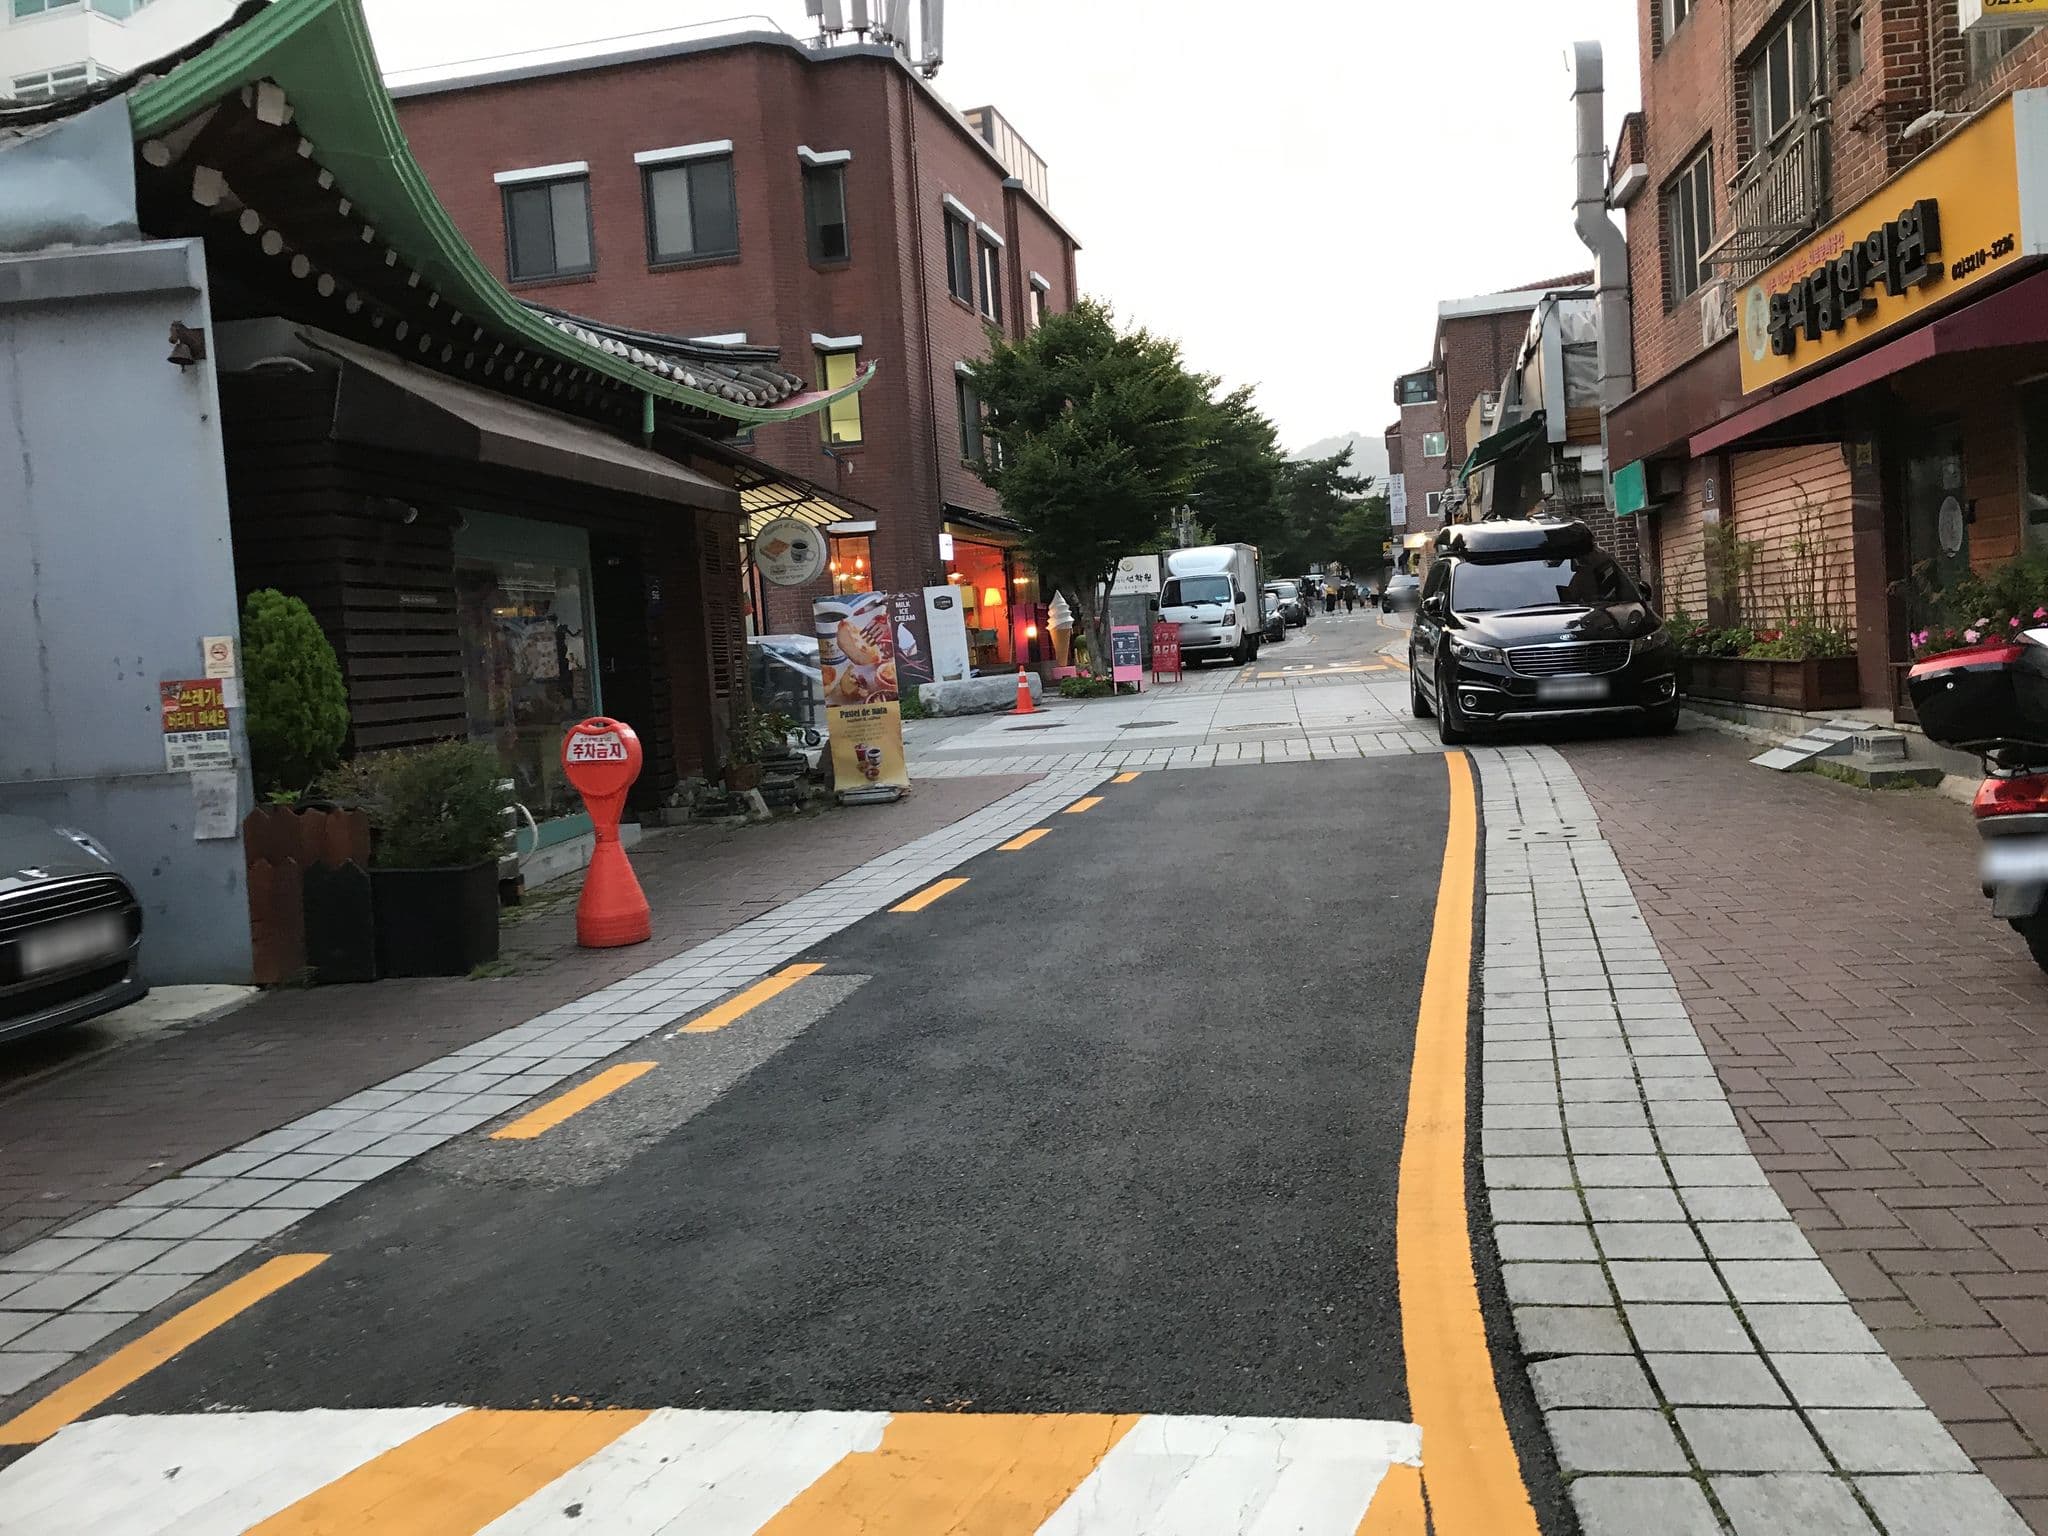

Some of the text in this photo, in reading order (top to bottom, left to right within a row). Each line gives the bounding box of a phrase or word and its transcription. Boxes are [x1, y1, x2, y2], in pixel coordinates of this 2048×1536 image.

[894, 614, 916, 622] CREAM
[167, 708, 227, 729] 버리지 마세요
[840, 709, 860, 718] Pastel
[862, 708, 870, 716] de
[573, 743, 622, 759] 주차금지
